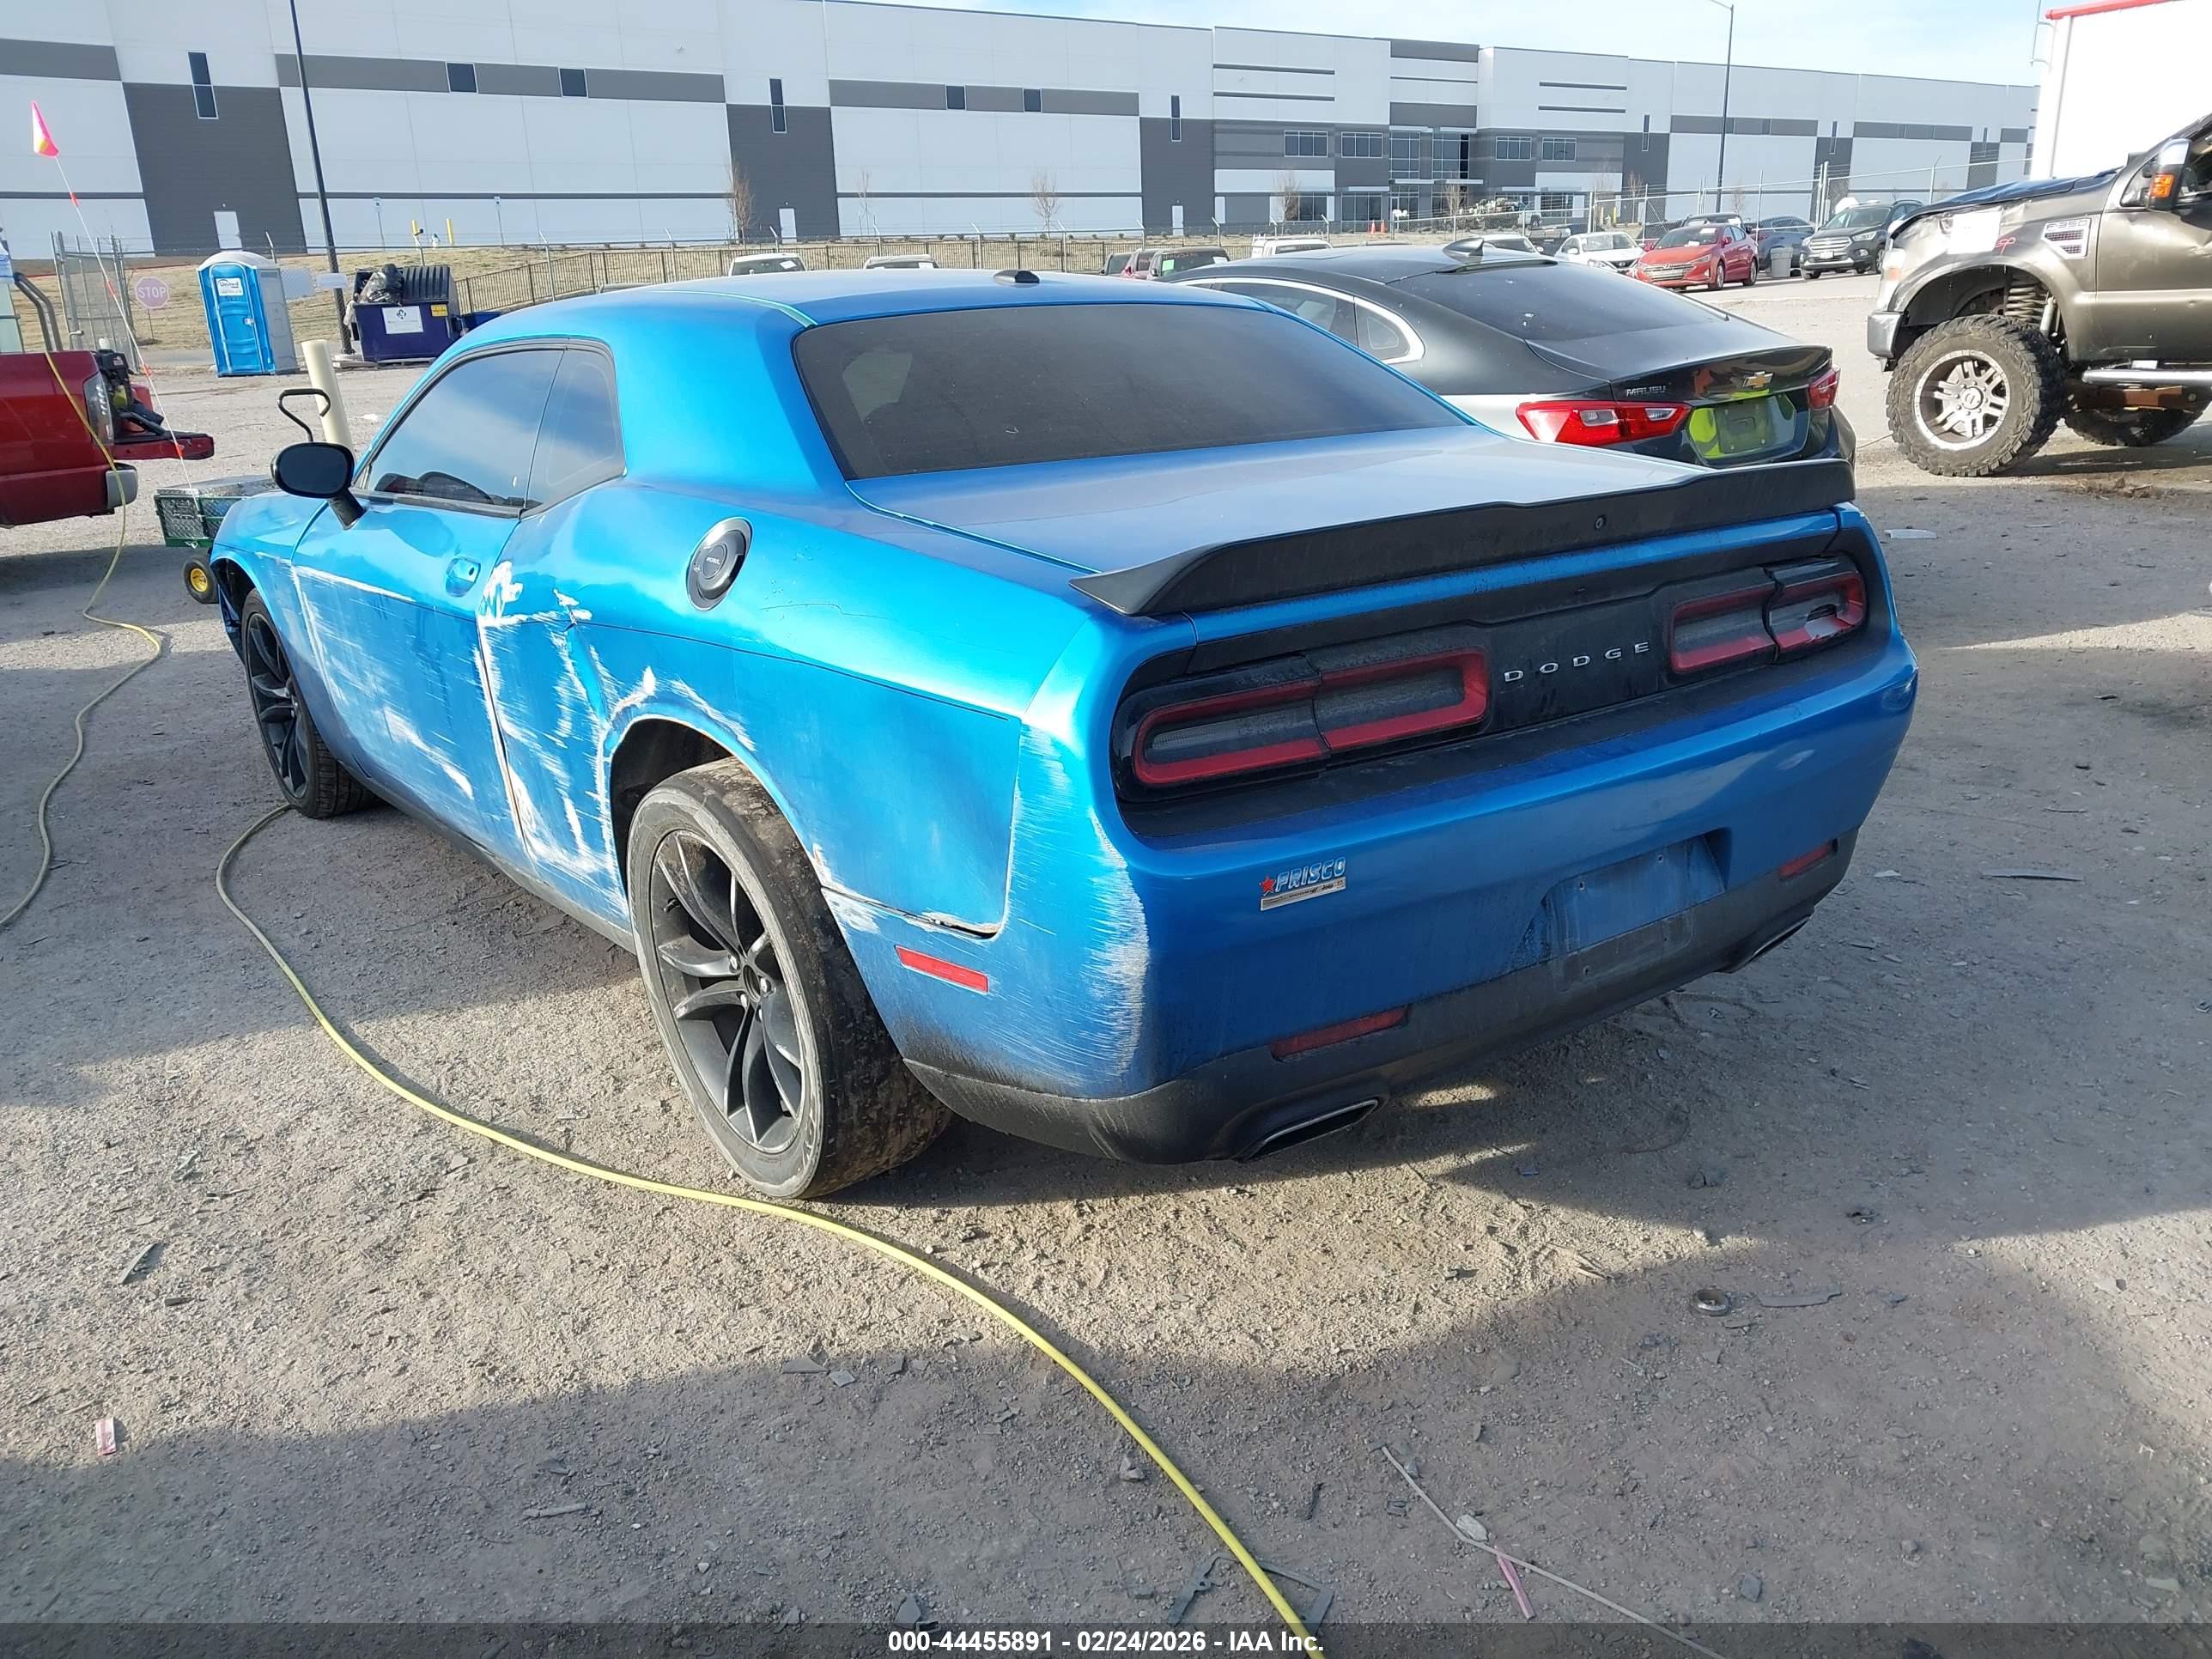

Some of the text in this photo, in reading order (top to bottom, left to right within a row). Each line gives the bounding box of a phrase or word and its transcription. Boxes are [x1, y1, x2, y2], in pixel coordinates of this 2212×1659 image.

[138, 287, 167, 299] STOP
[1504, 641, 1650, 682] DODGE
[1275, 856, 1346, 893] FRISCO
